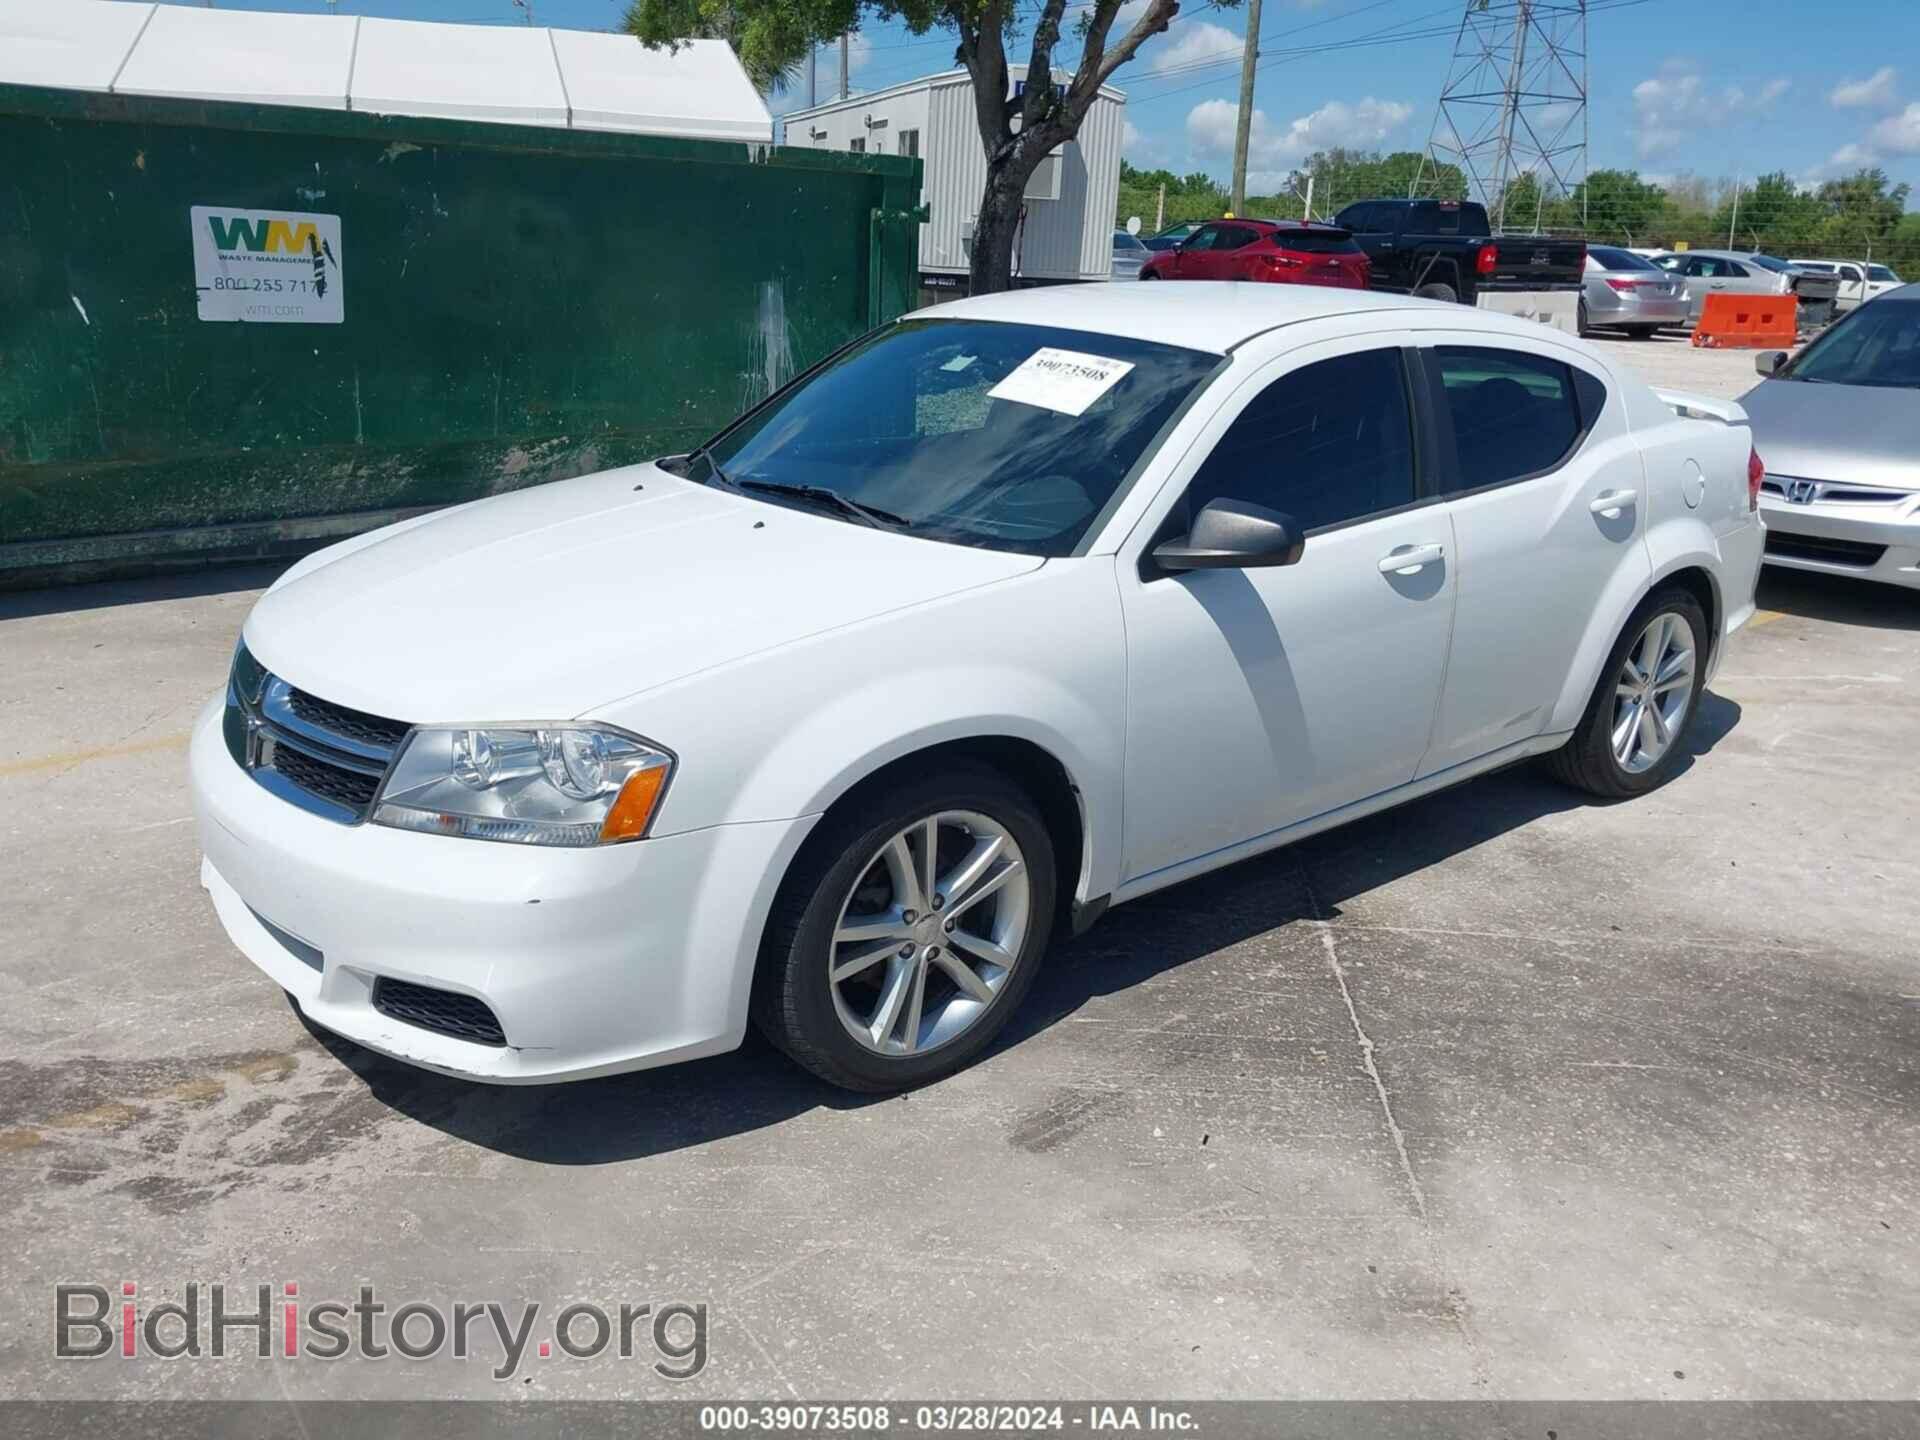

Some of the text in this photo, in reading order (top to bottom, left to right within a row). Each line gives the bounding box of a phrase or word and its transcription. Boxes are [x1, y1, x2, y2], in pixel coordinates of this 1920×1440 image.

[208, 216, 321, 255] WM
[219, 254, 319, 265] WASTE MANAGEME
[214, 277, 247, 291] 800
[253, 278, 283, 292] 255
[247, 305, 304, 317] wm.com
